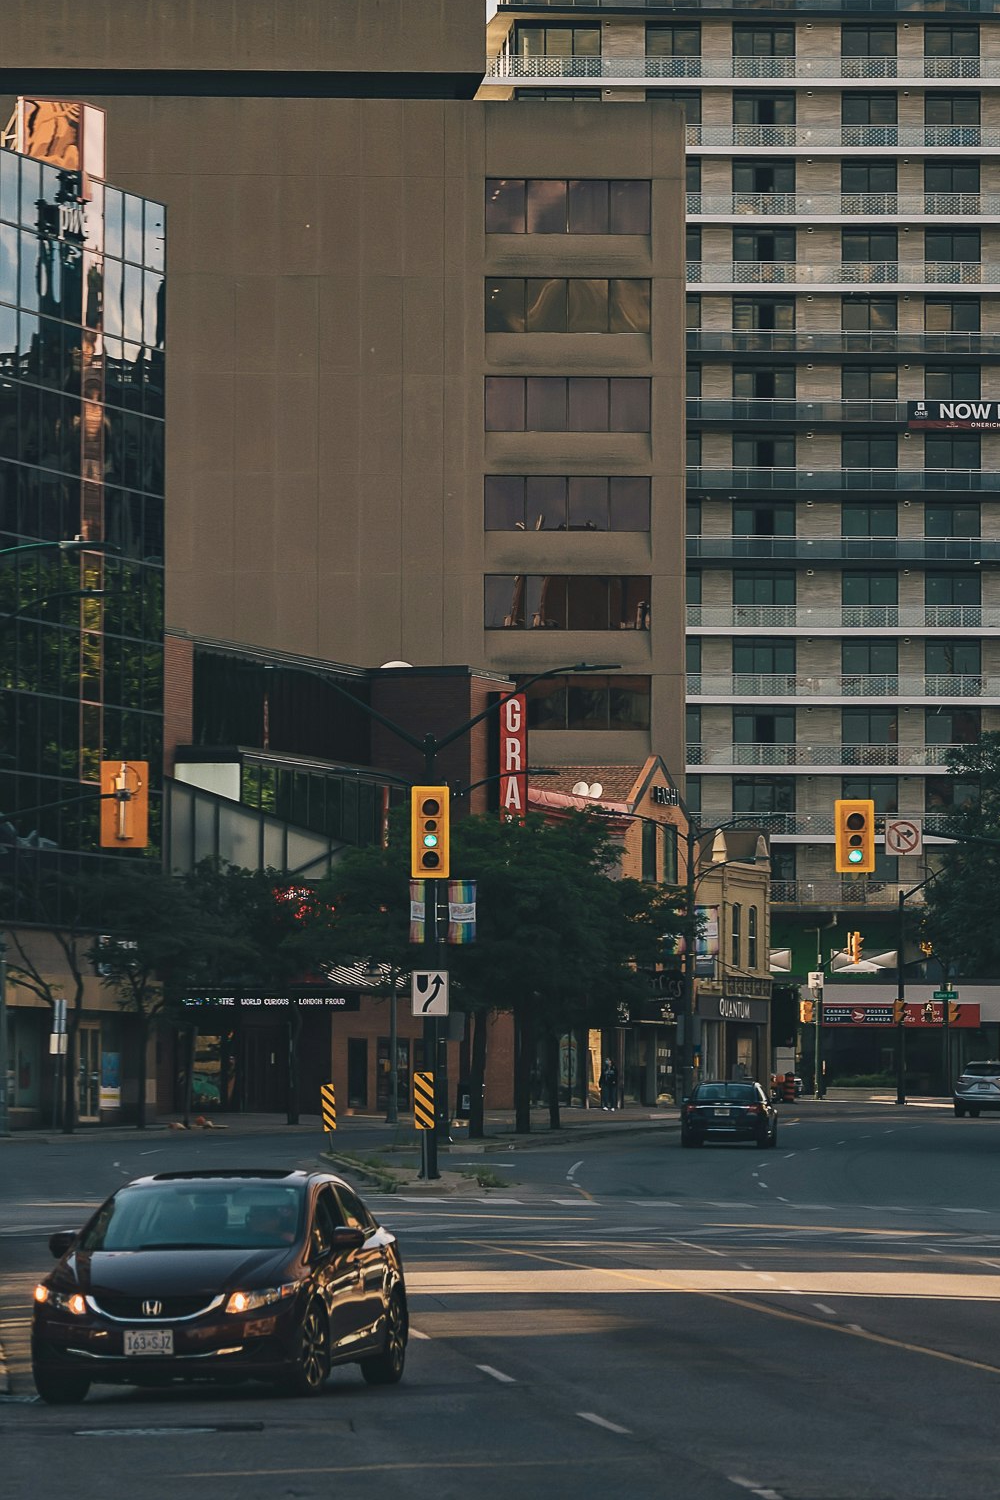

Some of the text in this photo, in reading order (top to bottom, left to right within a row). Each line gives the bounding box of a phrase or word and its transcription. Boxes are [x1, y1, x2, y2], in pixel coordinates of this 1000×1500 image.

[939, 403, 991, 419] NOW
[240, 998, 262, 1006] WORLD
[264, 998, 290, 1006] CURIOUS
[298, 998, 323, 1006] LONDON
[324, 998, 346, 1006] PROUD
[719, 998, 750, 1019] QUANTUM
